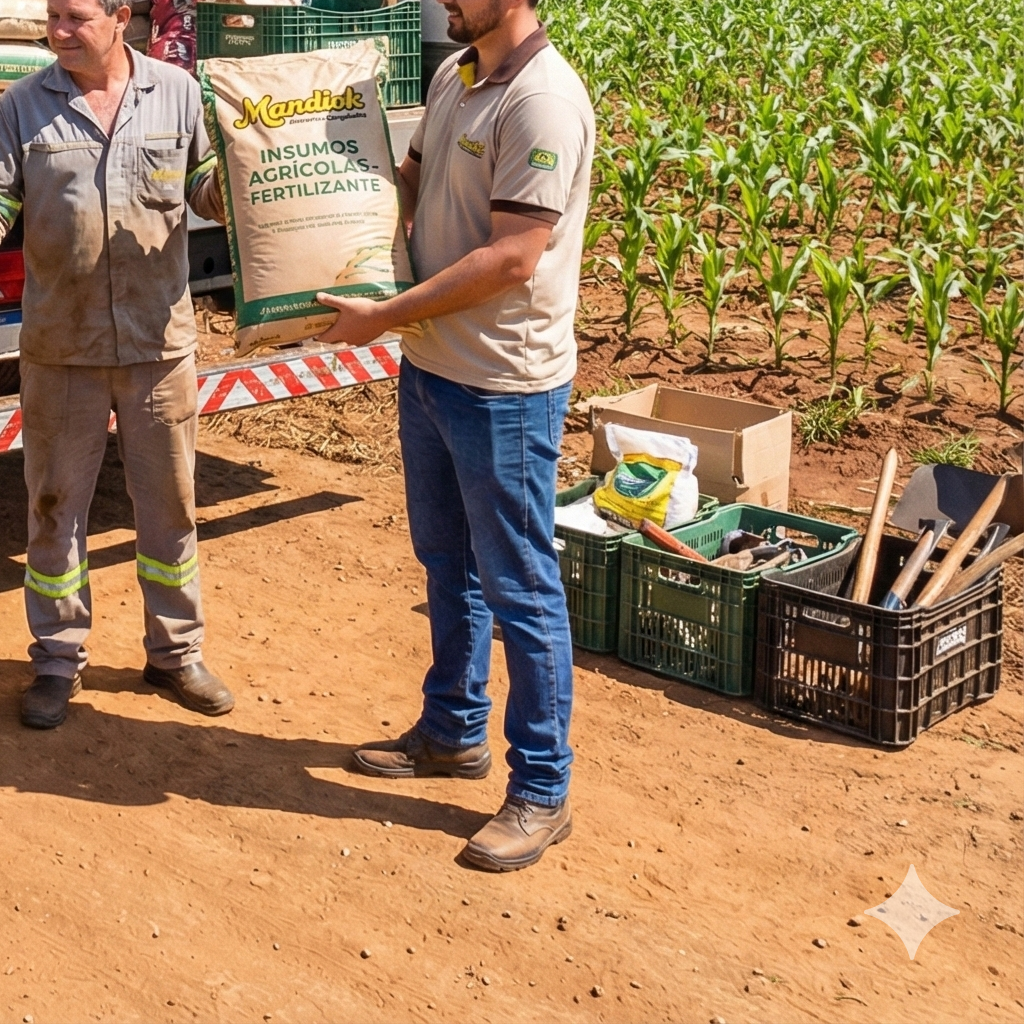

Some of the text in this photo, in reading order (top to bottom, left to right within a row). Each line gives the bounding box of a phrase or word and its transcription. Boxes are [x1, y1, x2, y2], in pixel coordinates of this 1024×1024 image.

[233, 85, 365, 130] Mandiok
[260, 139, 359, 164] INSUMOS
[250, 178, 381, 206] FERTILIZANTE
